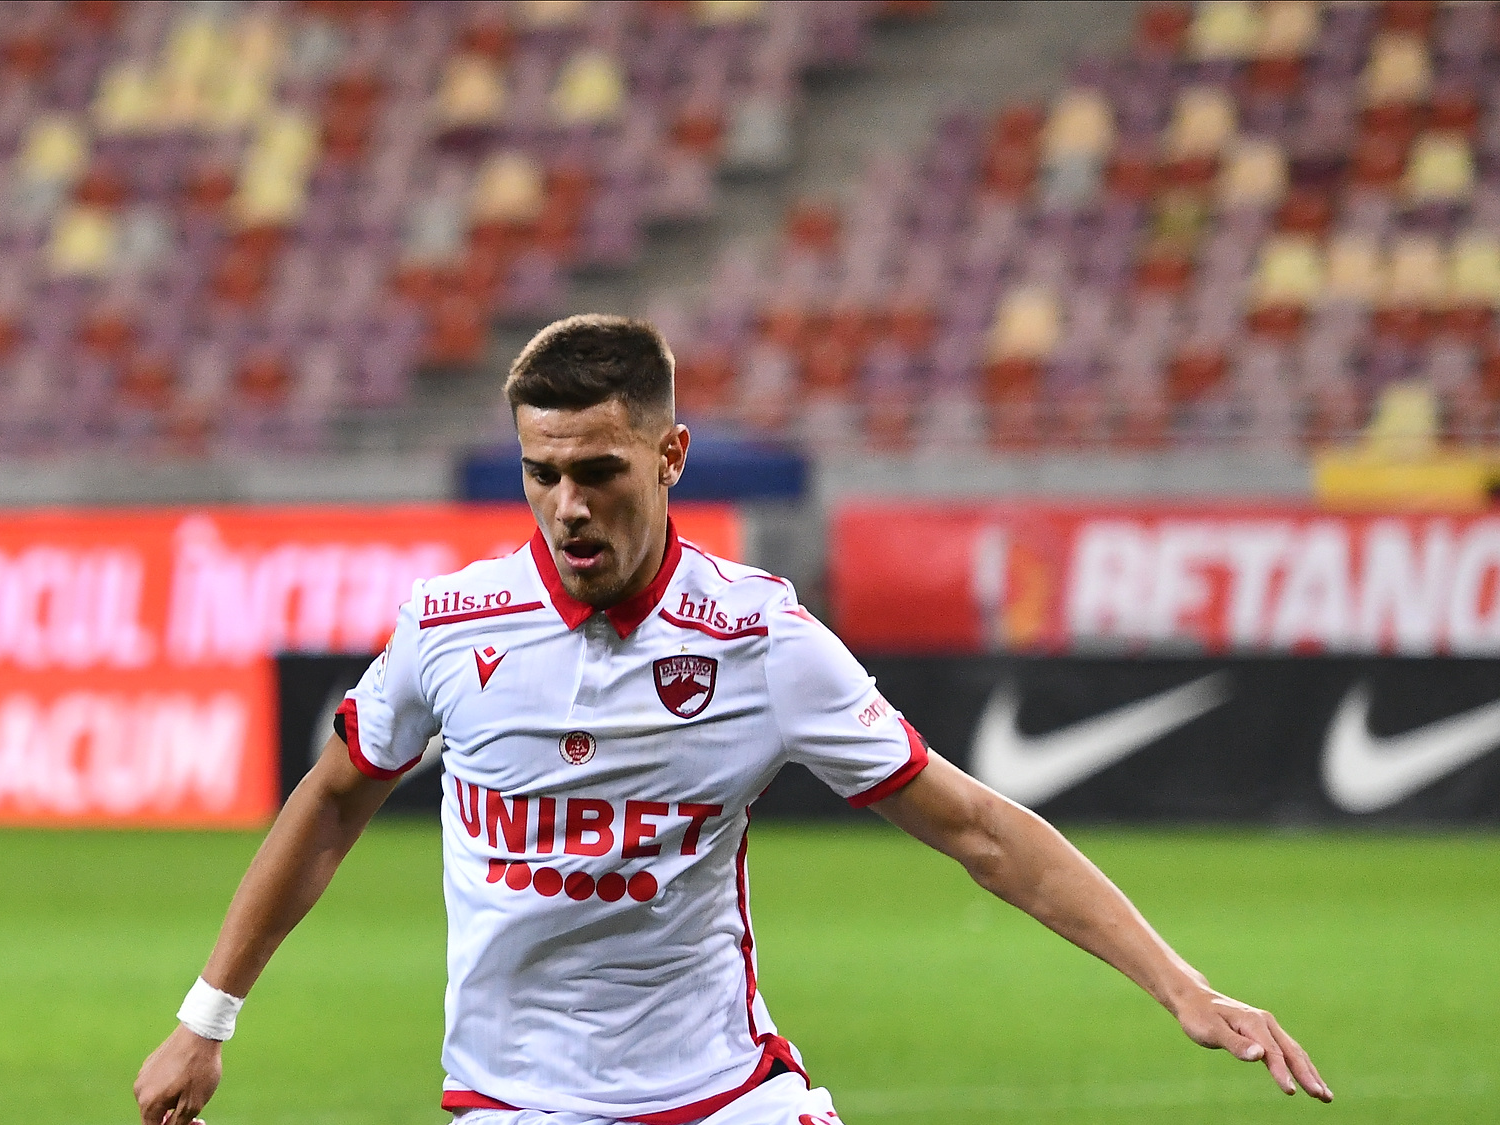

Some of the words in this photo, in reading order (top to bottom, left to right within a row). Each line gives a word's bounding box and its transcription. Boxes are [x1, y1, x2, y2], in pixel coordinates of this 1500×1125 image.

[423, 588, 512, 616] hils.ro
[677, 593, 762, 633] hils.ro
[660, 661, 712, 676] DINAMO
[455, 776, 725, 859] UNIBET
